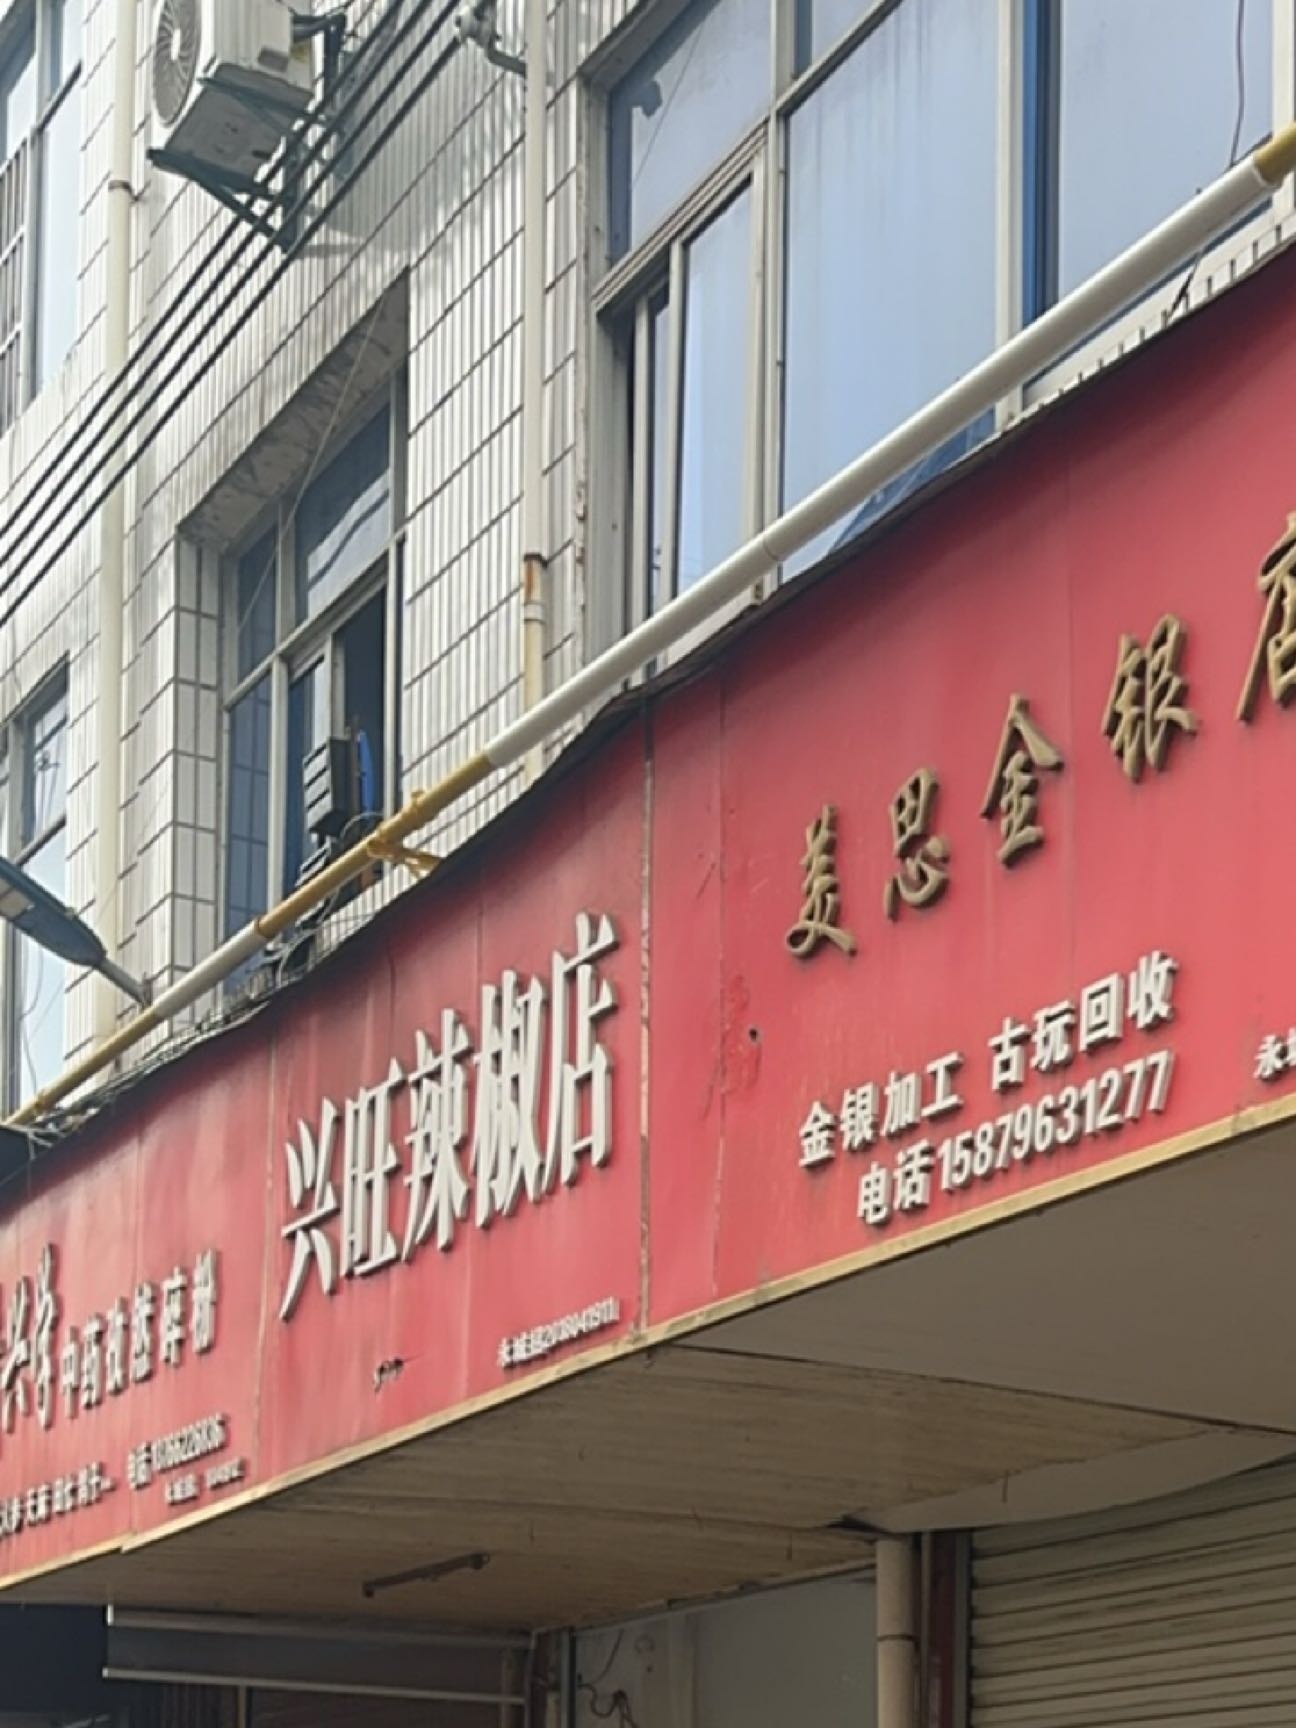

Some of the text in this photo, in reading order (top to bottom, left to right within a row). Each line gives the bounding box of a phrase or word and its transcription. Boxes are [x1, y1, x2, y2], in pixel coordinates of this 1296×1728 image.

[279, 911, 619, 1322] 兴旺辣椒店
[798, 949, 1180, 1169] 金银加工 古玩回收
